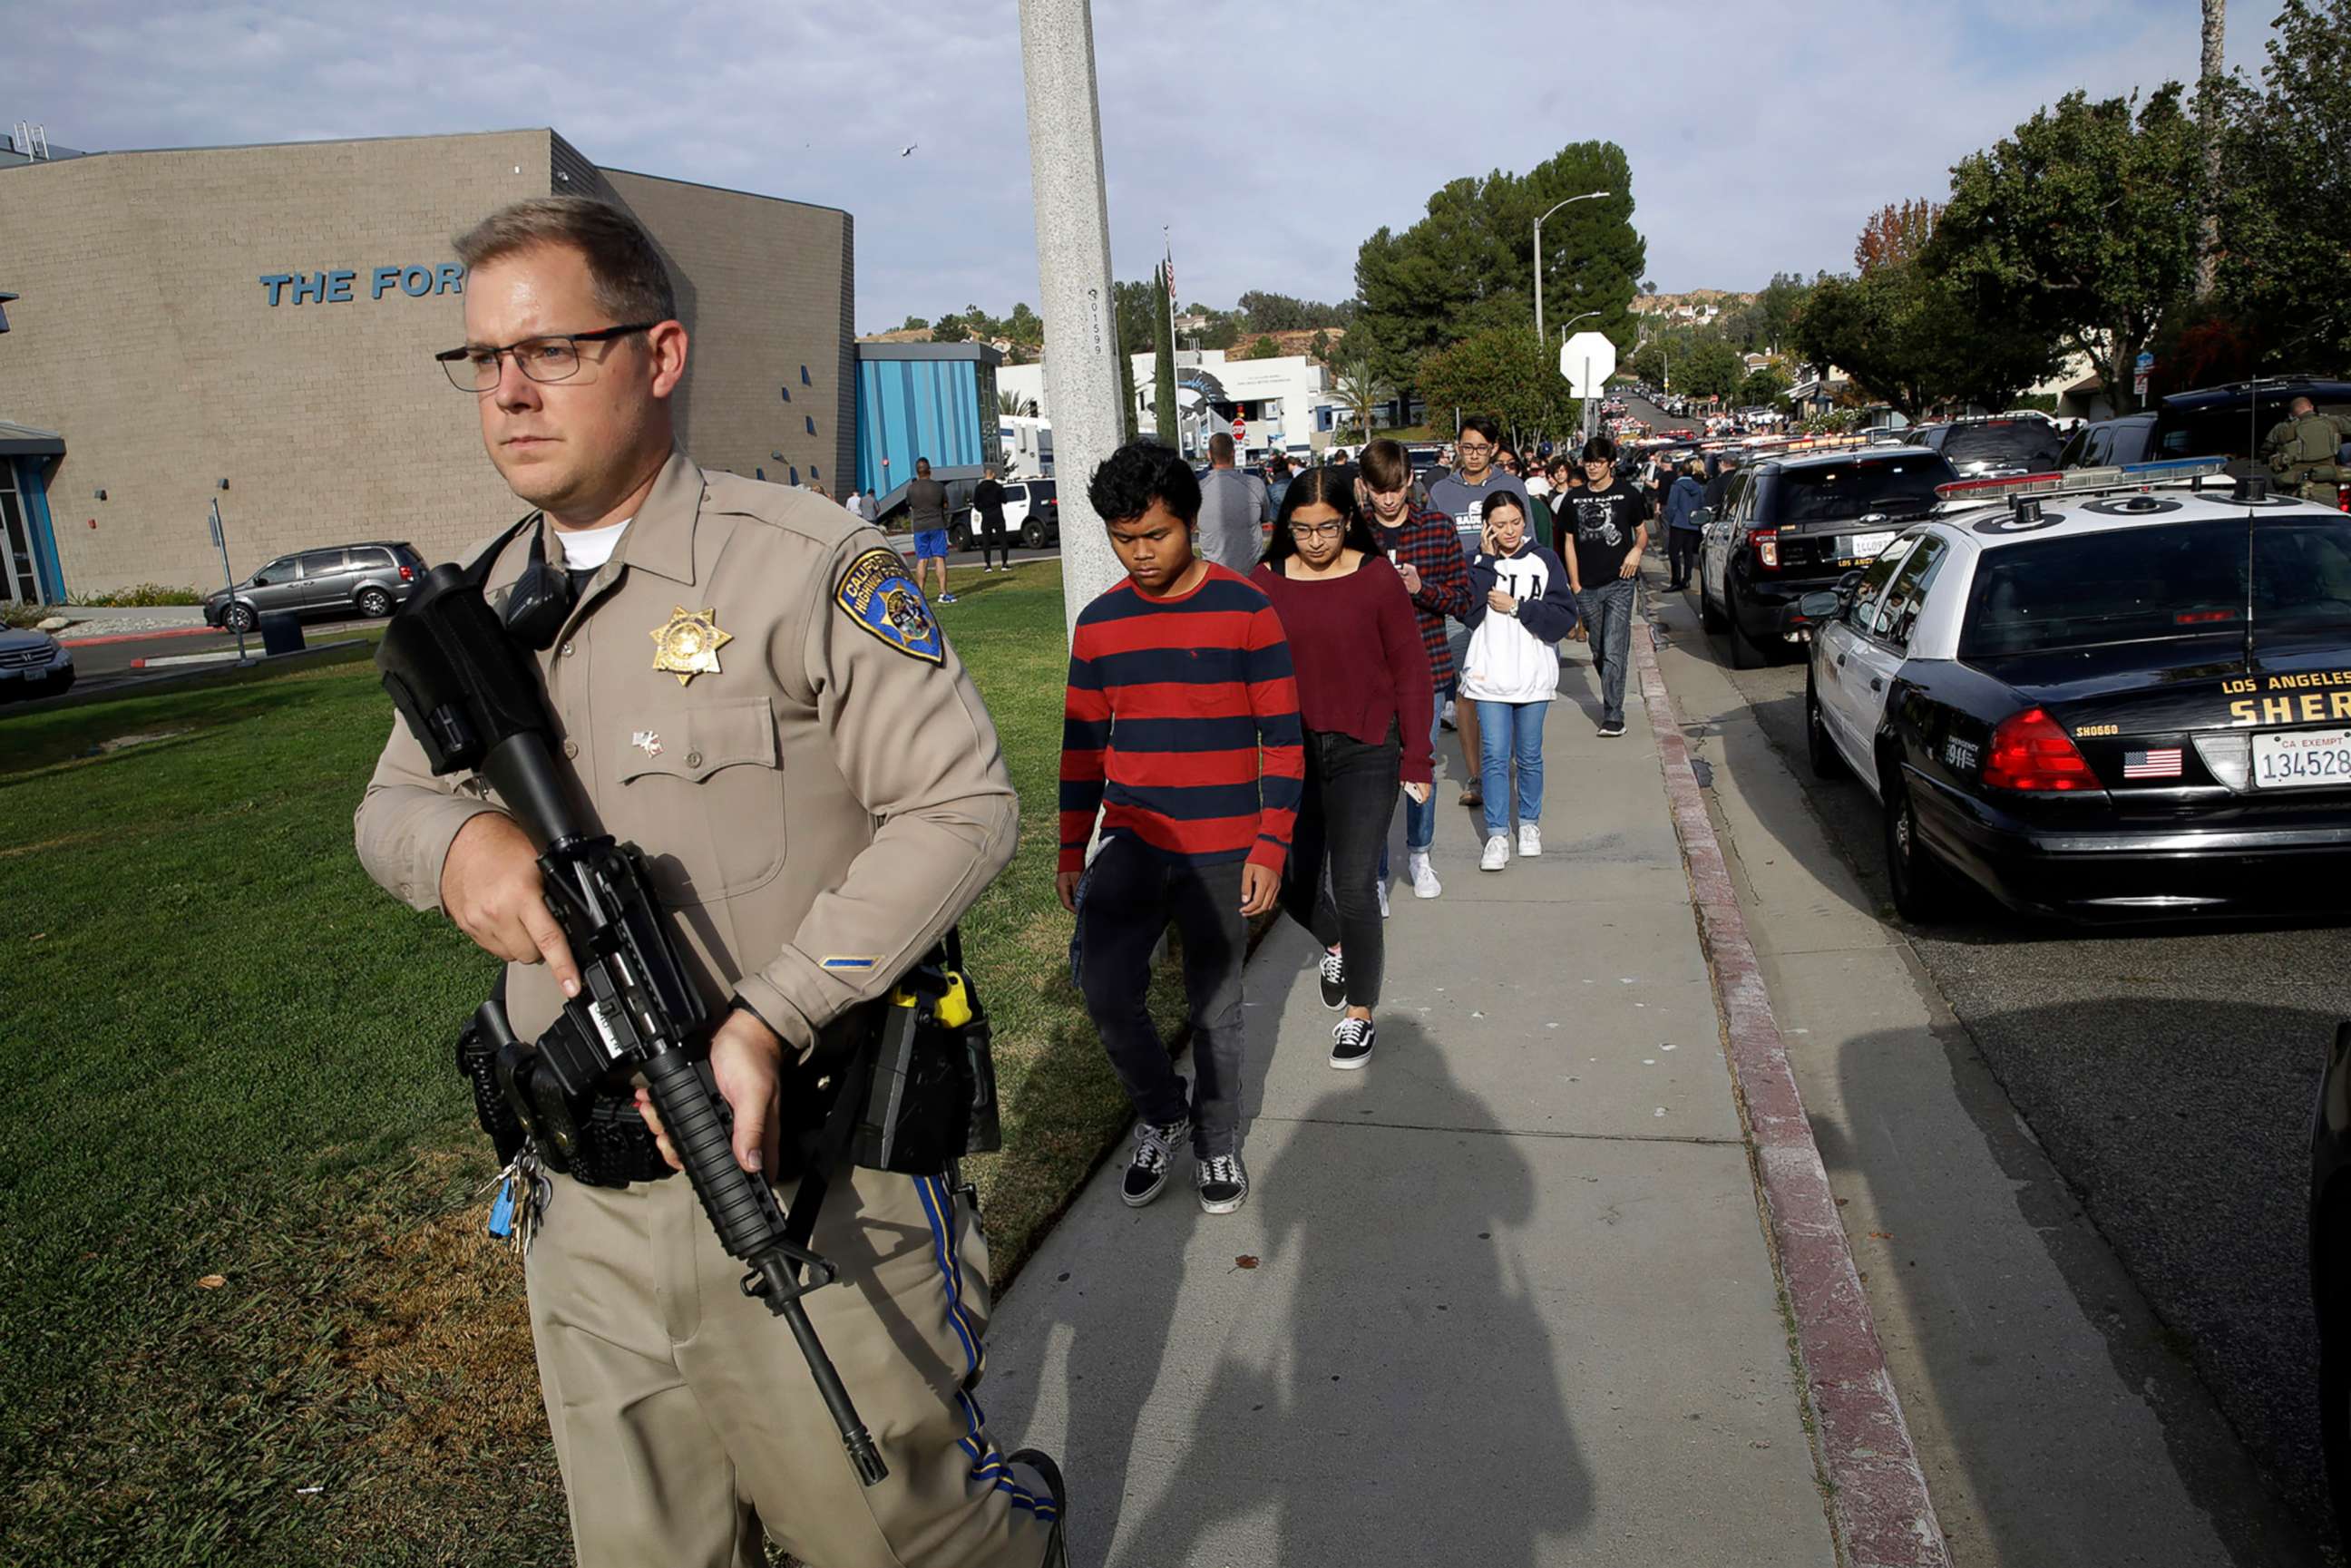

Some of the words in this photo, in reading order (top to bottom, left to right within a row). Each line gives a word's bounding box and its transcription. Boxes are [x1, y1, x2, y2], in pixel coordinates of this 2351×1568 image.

[259, 269, 355, 306] THE
[1091, 303, 1101, 355] 01599
[854, 571, 886, 615] HIGHWAY
[2222, 679, 2257, 694] LOS
[2268, 671, 2351, 689] ANGELES
[2230, 691, 2351, 725] SHER
[1949, 745, 1966, 768] 911
[2282, 740, 2297, 748] CA
[2302, 737, 2343, 747] EXEMPT
[2264, 749, 2351, 779] 134528
